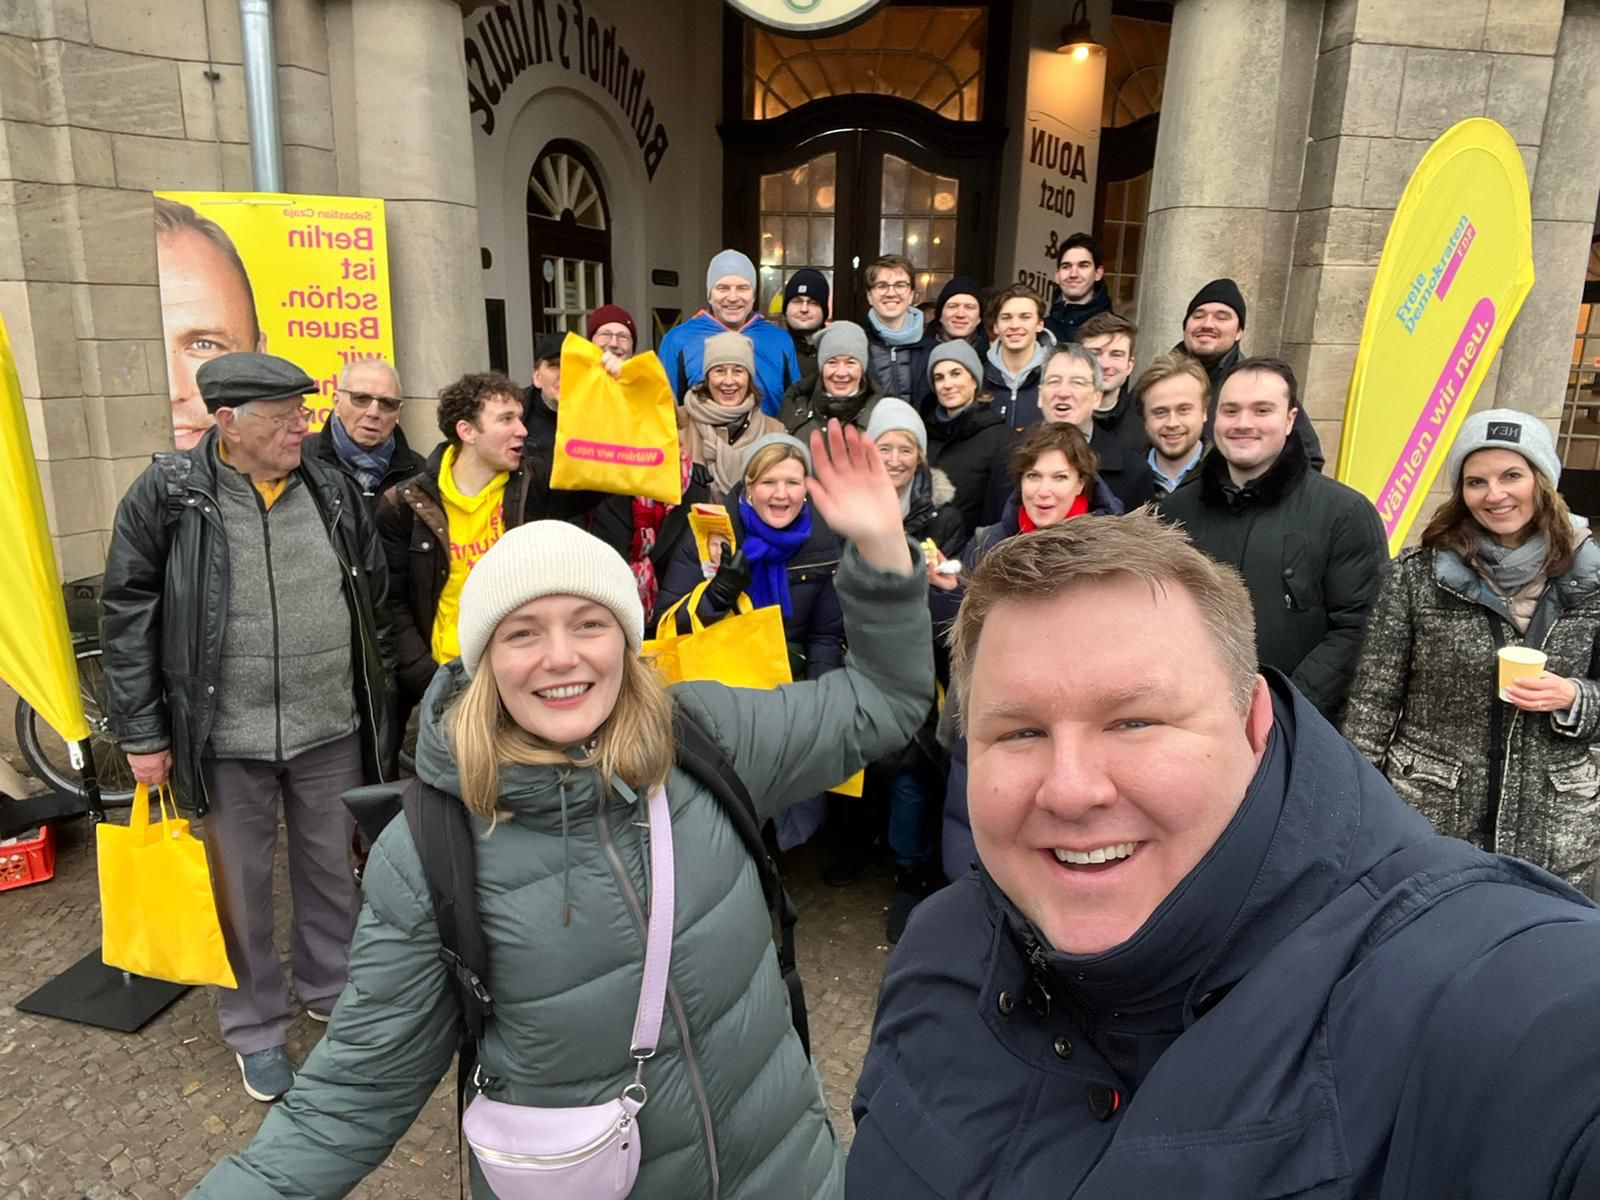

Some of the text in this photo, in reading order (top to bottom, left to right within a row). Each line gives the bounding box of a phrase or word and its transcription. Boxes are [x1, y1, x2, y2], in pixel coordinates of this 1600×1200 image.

[1404, 214, 1468, 335] Demokraten
[1456, 227, 1474, 257] FDP
[1396, 272, 1426, 321] Freie
[1429, 378, 1456, 427] wir
[1454, 319, 1490, 379] neu.
